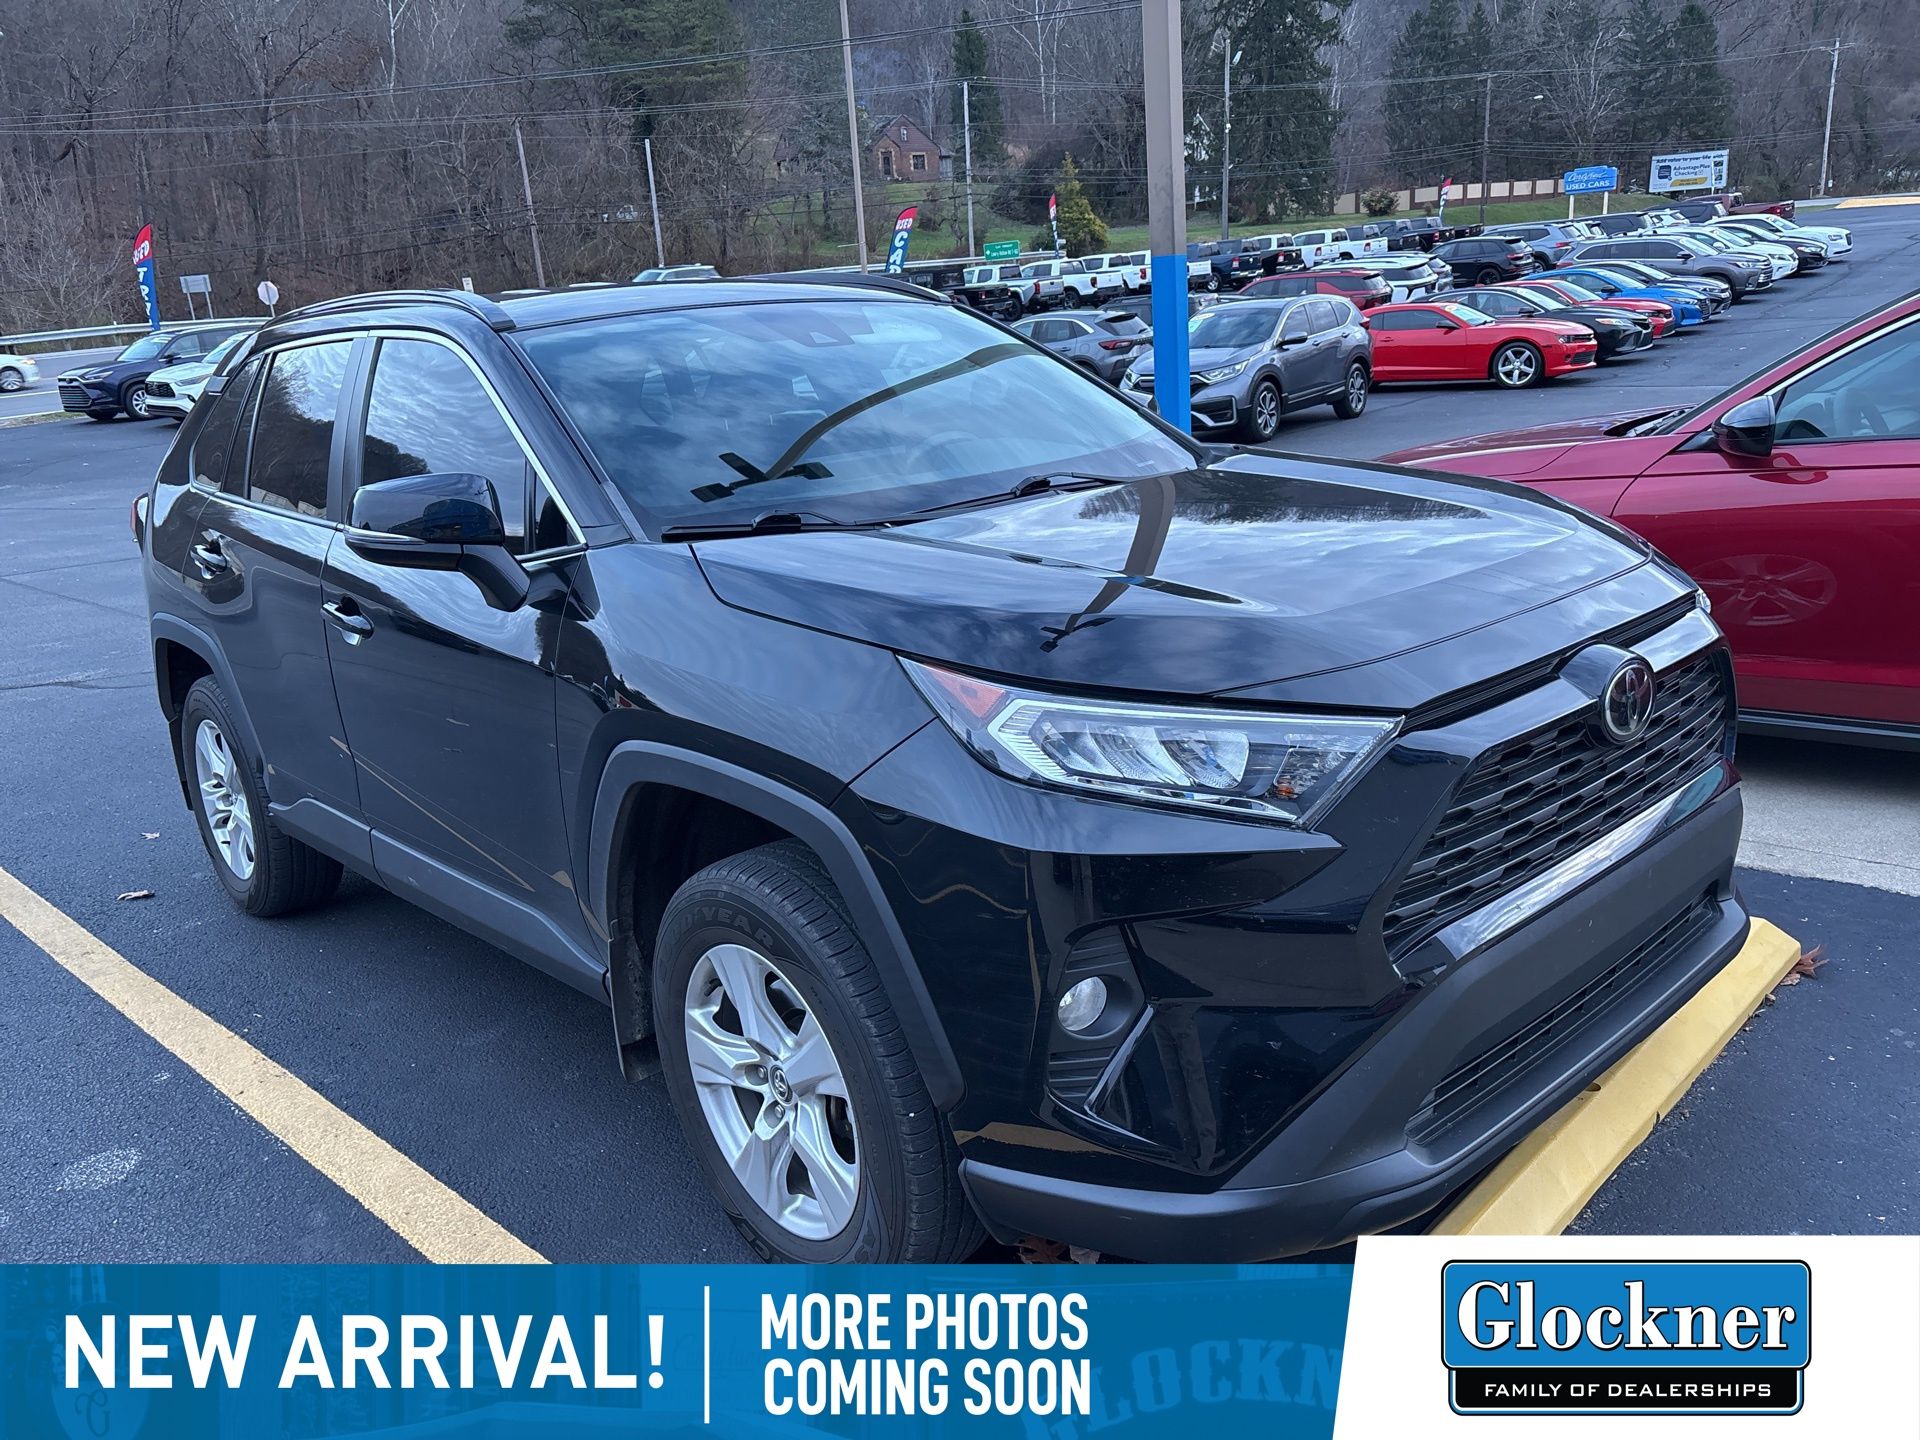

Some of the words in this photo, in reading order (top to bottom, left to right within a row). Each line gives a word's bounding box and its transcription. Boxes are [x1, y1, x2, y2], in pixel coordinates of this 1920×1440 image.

[1566, 182, 1586, 190] USED
[1588, 180, 1610, 188] CARS
[896, 217, 913, 231] USED
